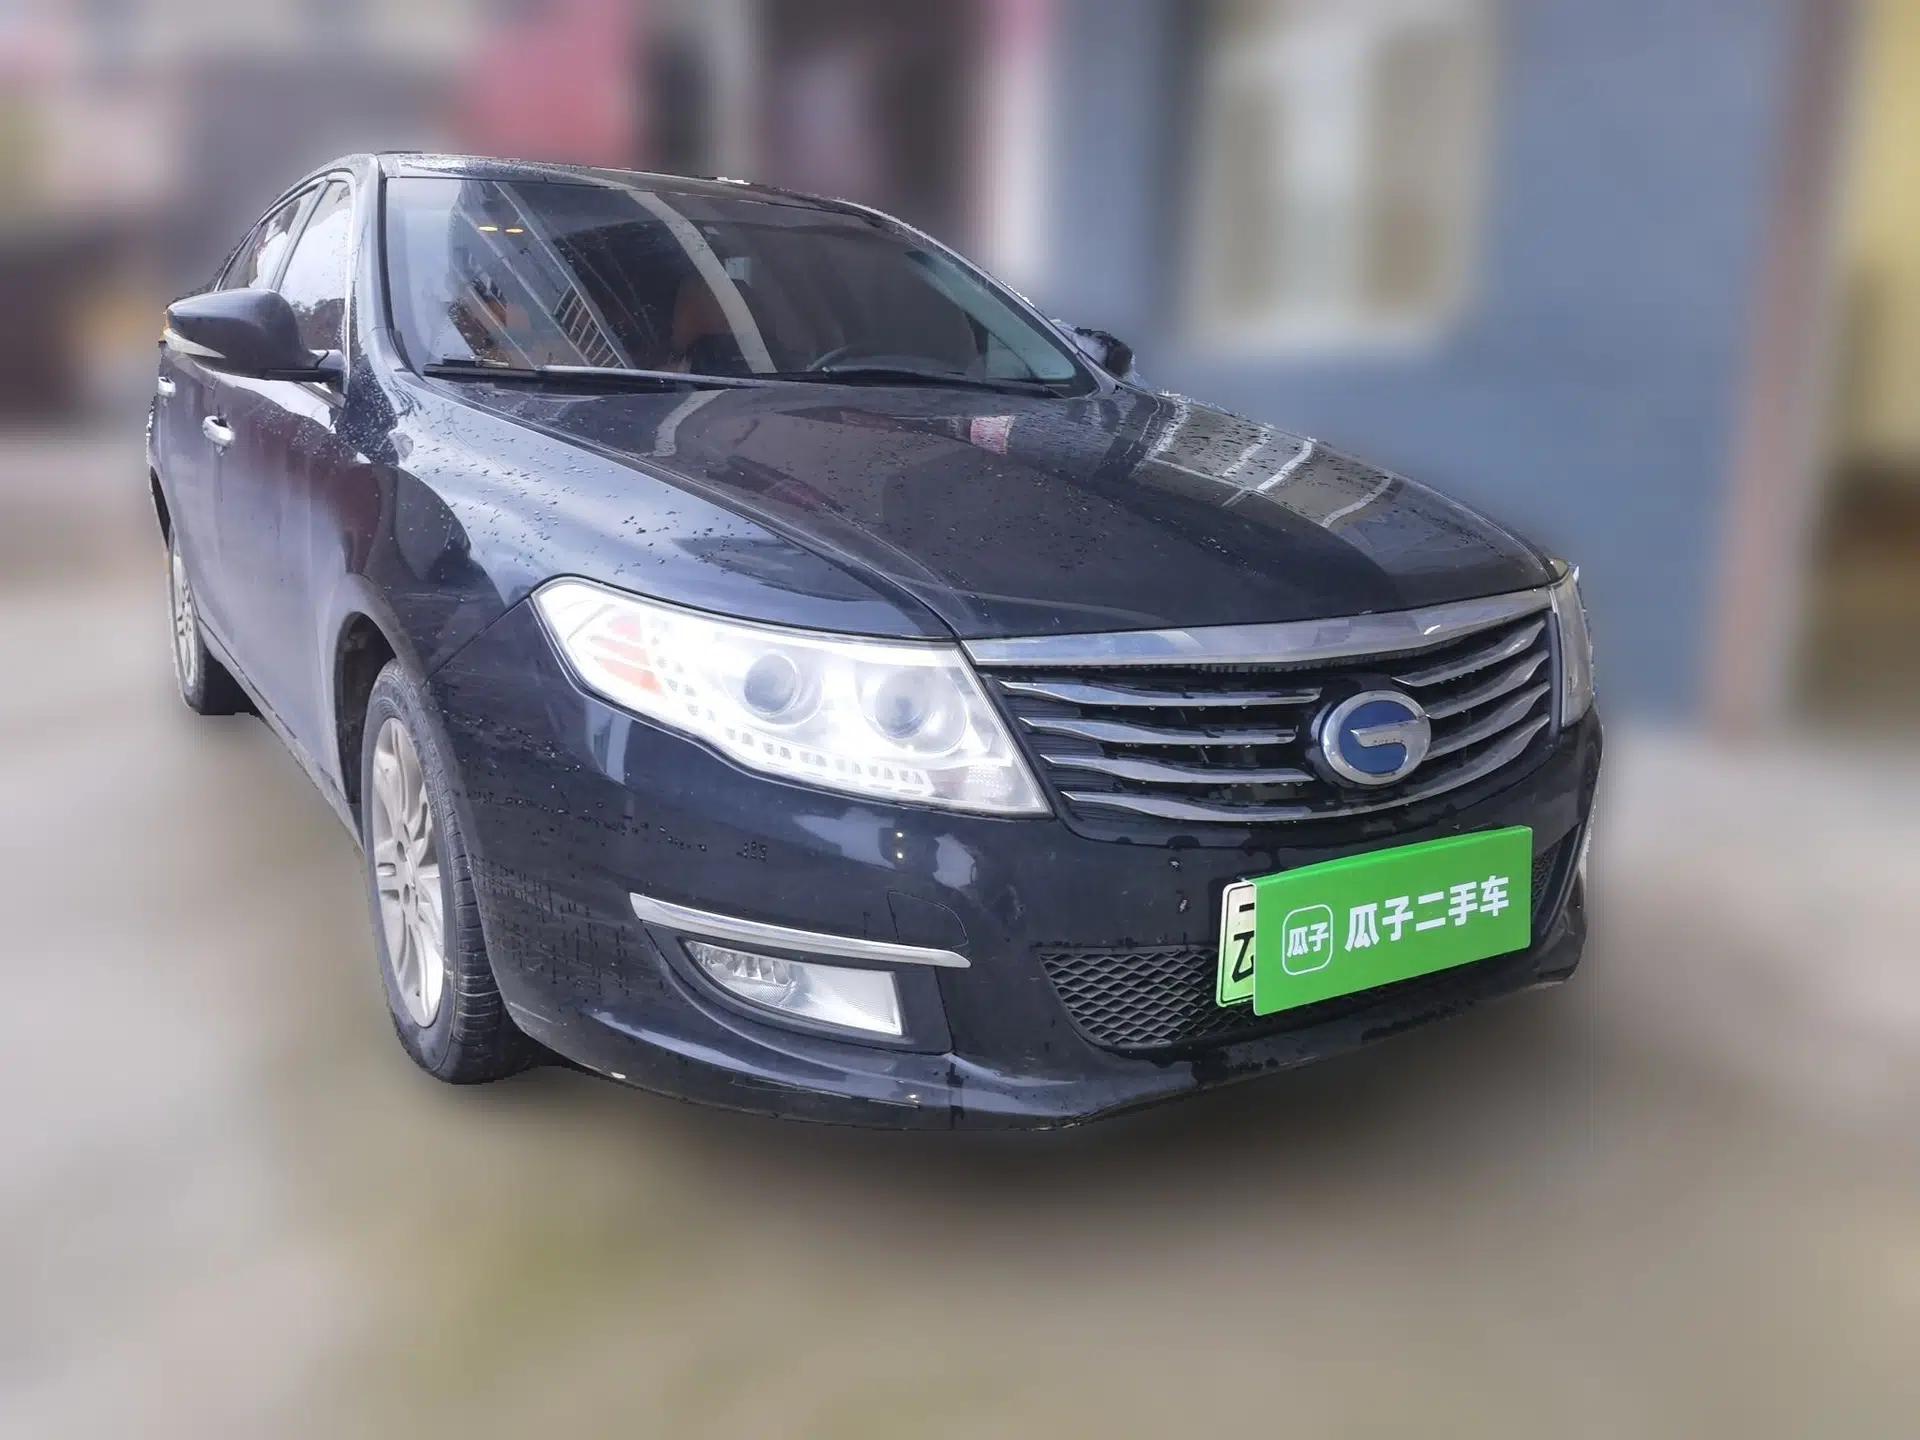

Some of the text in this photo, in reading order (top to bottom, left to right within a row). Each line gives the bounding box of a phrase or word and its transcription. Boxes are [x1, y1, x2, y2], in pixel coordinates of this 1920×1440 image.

[1286, 921, 1330, 958] 瓜子
[1344, 875, 1510, 952] 瓜子二手车
